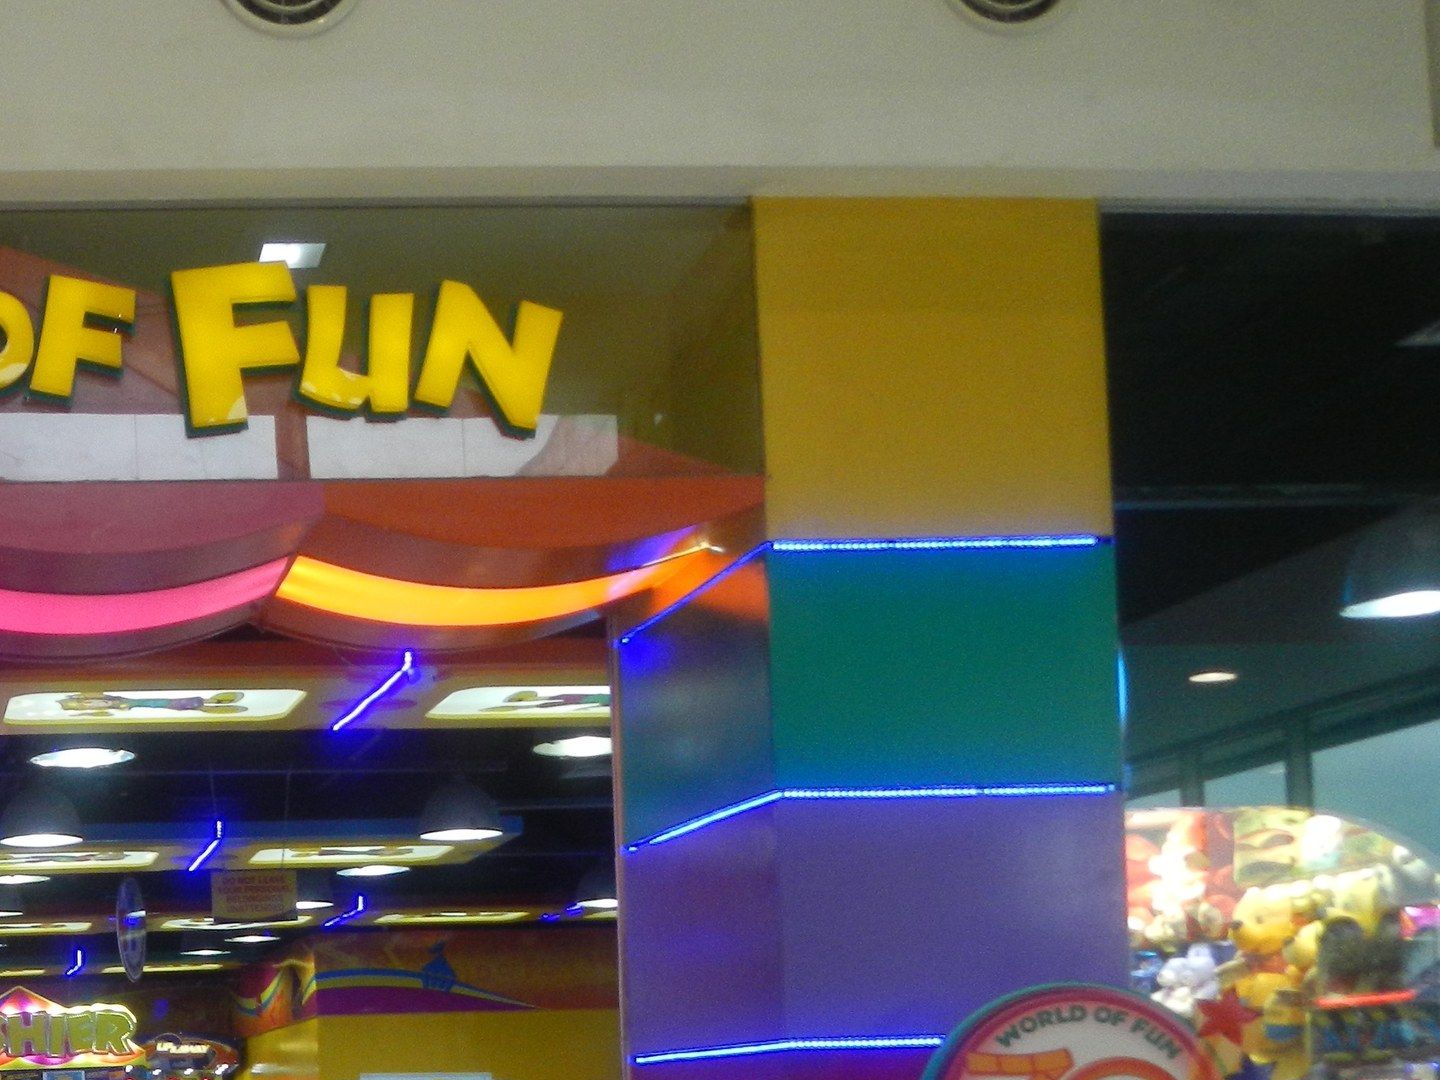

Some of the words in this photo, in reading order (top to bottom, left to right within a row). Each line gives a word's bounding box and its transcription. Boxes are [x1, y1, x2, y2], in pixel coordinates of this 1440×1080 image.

[170, 261, 563, 438] FUN
[996, 1005, 1087, 1047] WORLD
[1094, 1006, 1128, 1026] OF
[1130, 1018, 1182, 1059] FUN
